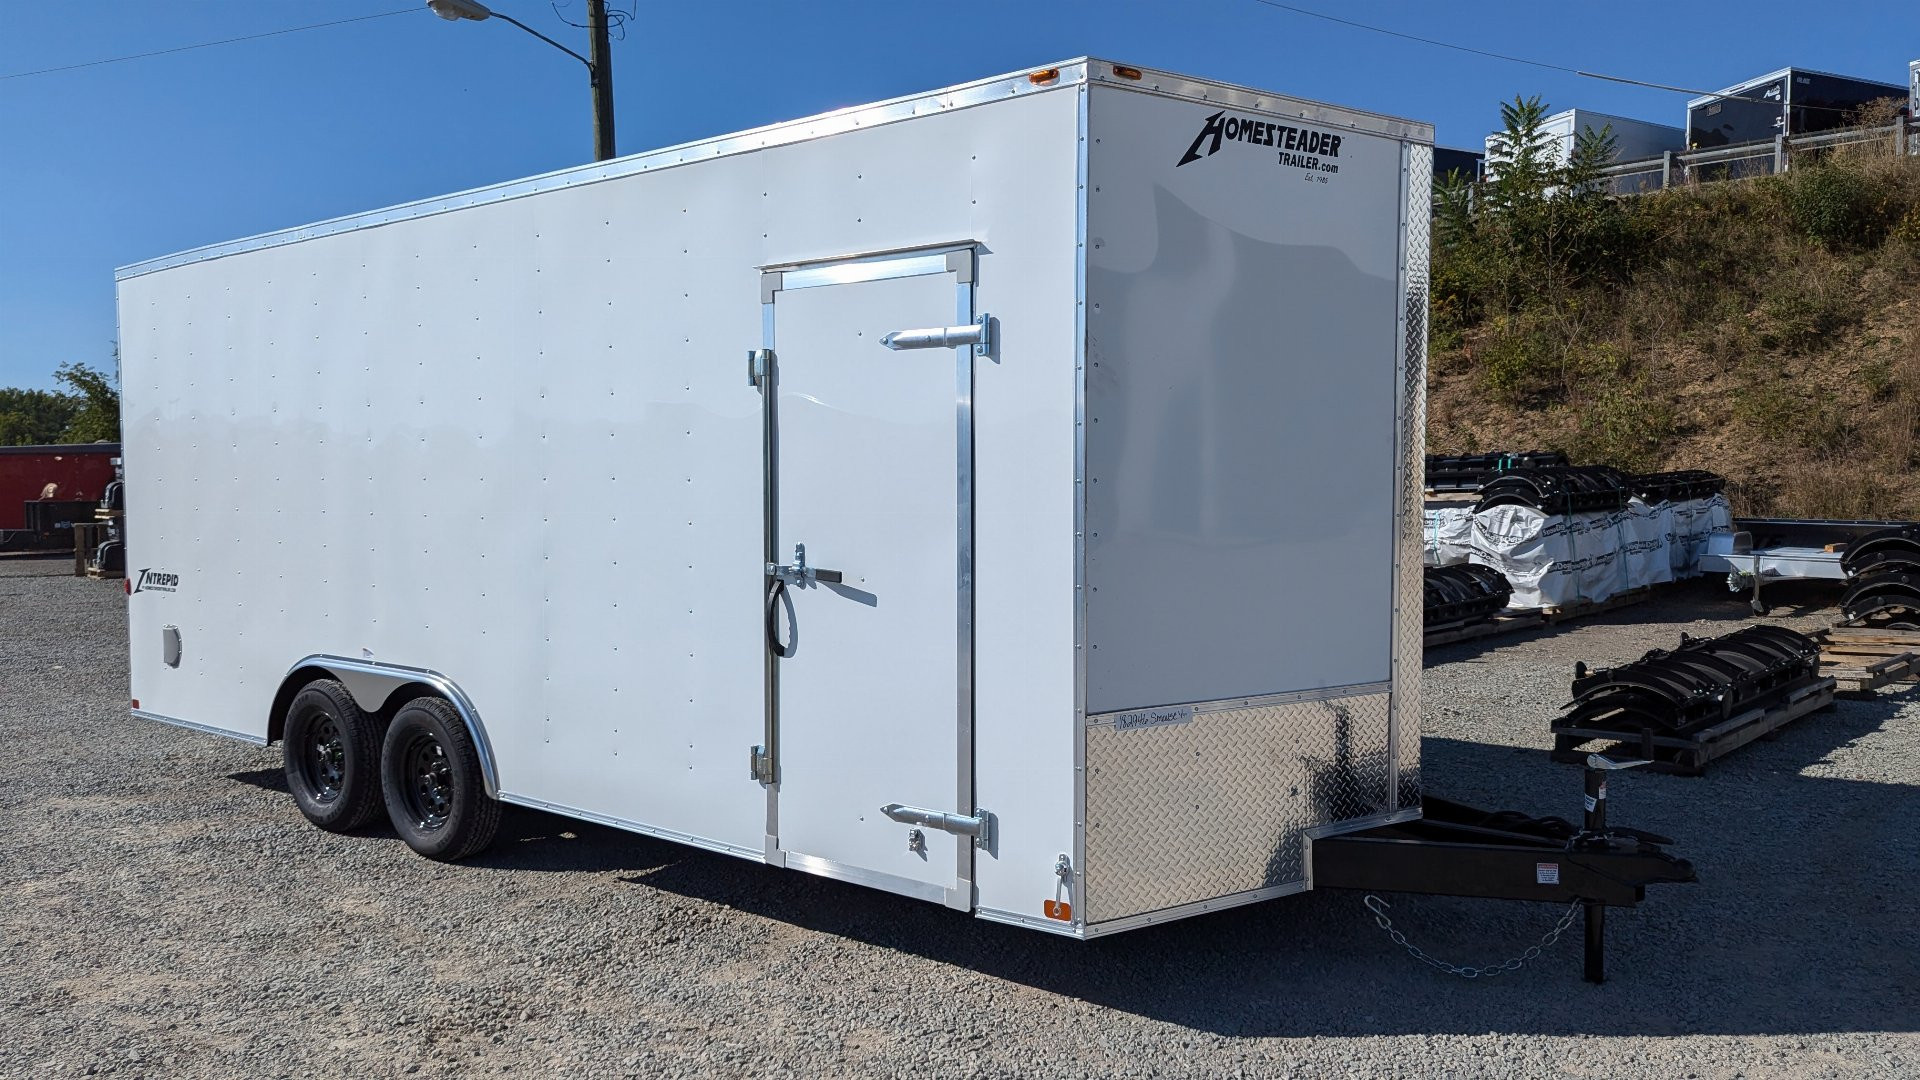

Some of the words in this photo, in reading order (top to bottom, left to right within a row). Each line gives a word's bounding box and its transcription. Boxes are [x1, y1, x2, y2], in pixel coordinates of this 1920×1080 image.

[1176, 110, 1342, 167] HOMESTEADER
[1278, 152, 1339, 174] TRAILER.com
[133, 567, 179, 594] INTREPID
